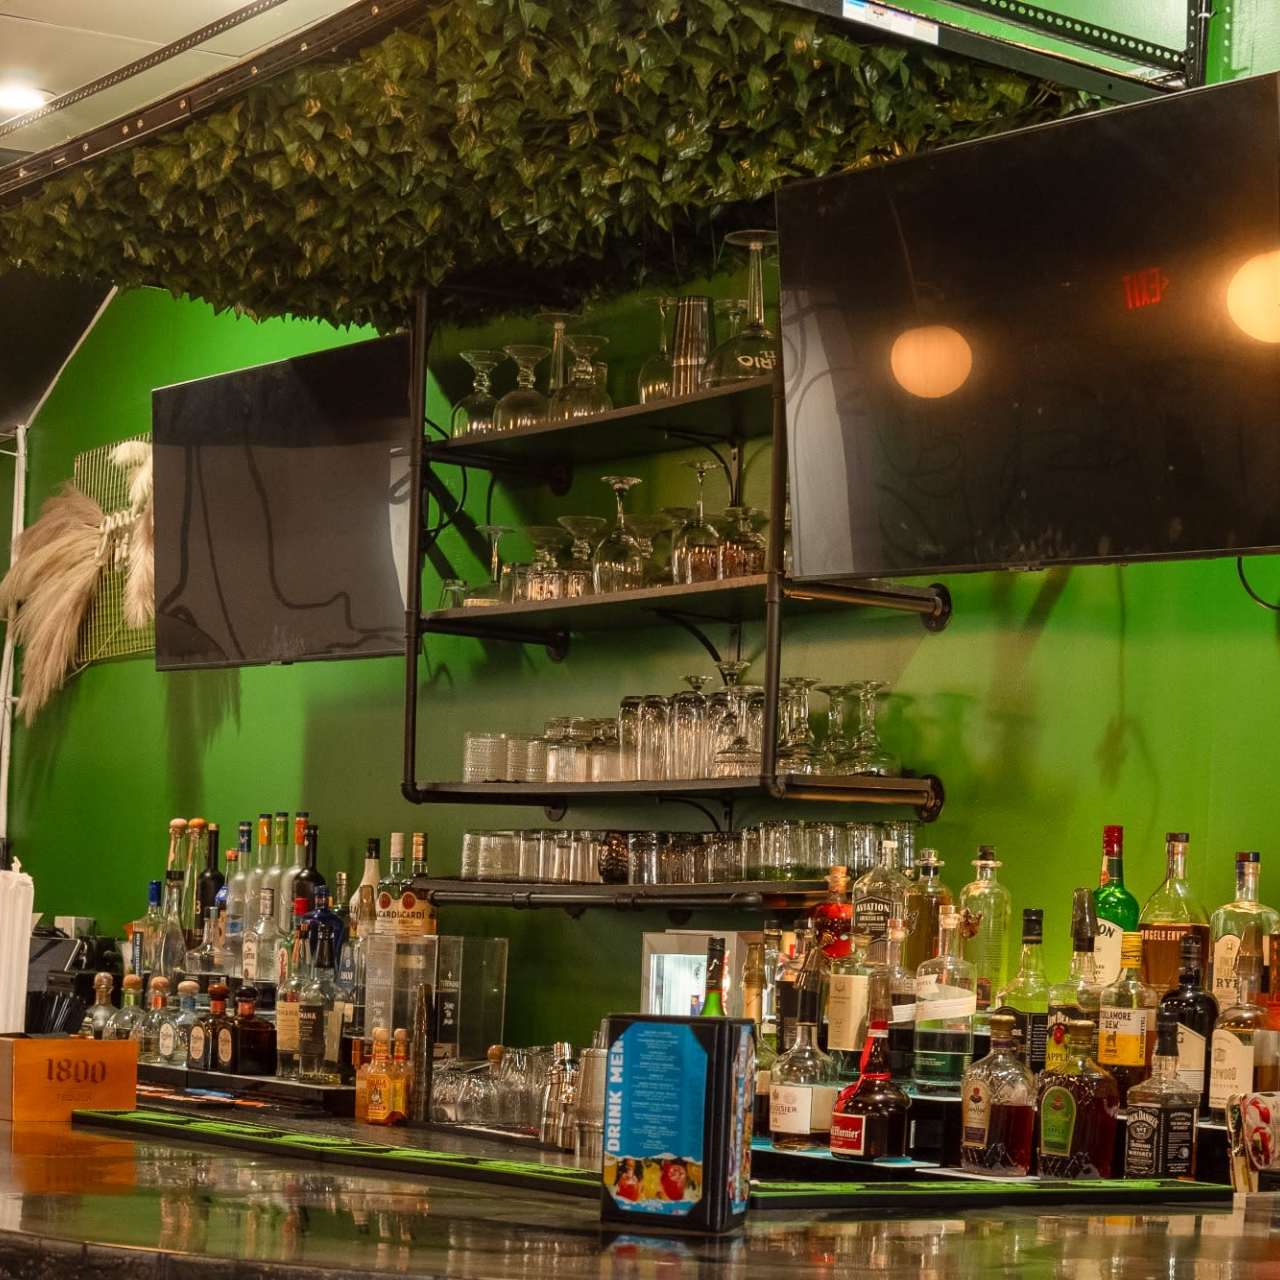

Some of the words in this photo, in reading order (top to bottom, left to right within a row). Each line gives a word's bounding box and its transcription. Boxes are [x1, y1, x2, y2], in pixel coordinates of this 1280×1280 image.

[855, 903, 890, 913] AVIATION
[47, 1058, 107, 1084] 1800
[610, 1035, 624, 1083] MEN
[607, 1091, 622, 1152] DRINK
